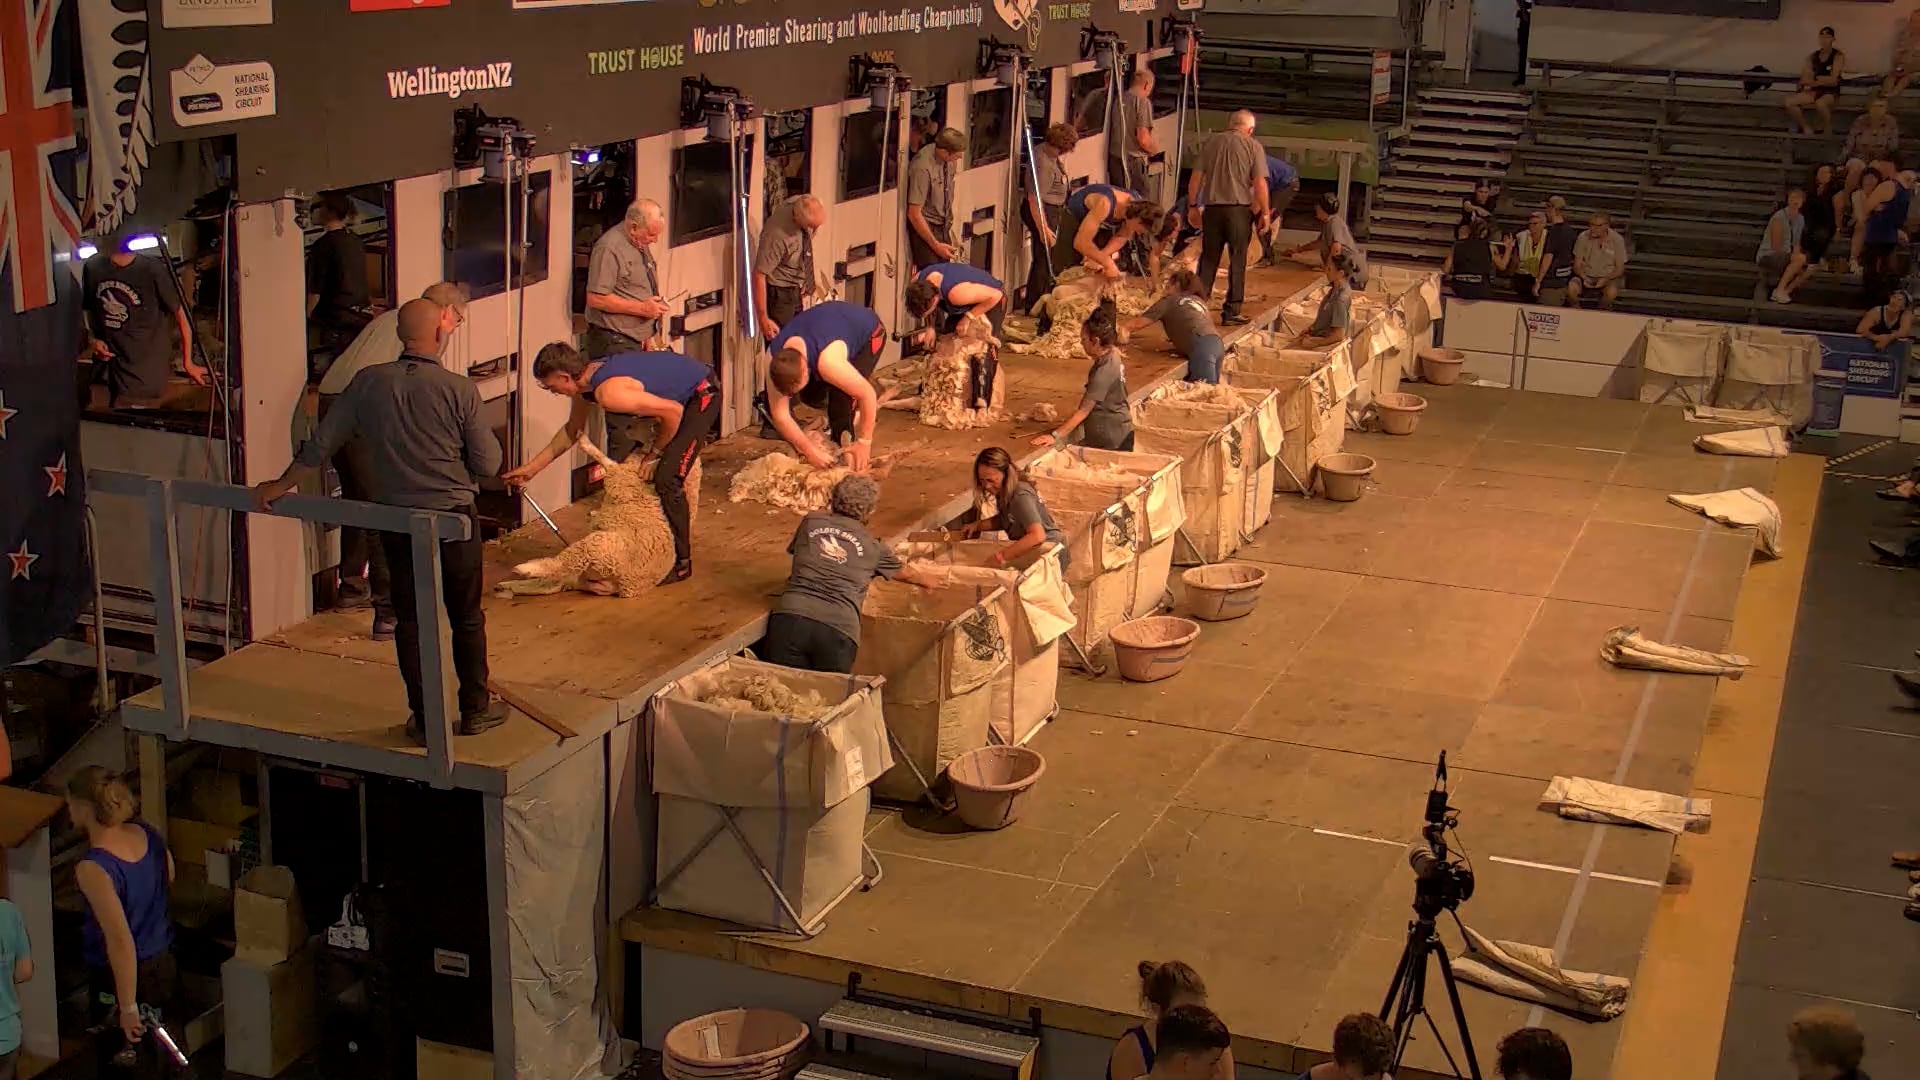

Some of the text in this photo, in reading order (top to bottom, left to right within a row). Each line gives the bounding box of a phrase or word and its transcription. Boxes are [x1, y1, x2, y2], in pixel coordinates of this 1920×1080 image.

[1048, 3, 1090, 20] TRUST HOUSE
[694, 3, 982, 55] World Premier Shearing and Woolhandling Championship
[588, 44, 685, 75] TRUST HOUSE
[234, 72, 269, 85] NATIONAL
[387, 61, 513, 99] WellingtonNZ
[235, 84, 270, 97] SHEARING
[235, 97, 263, 109] CIRCUIT
